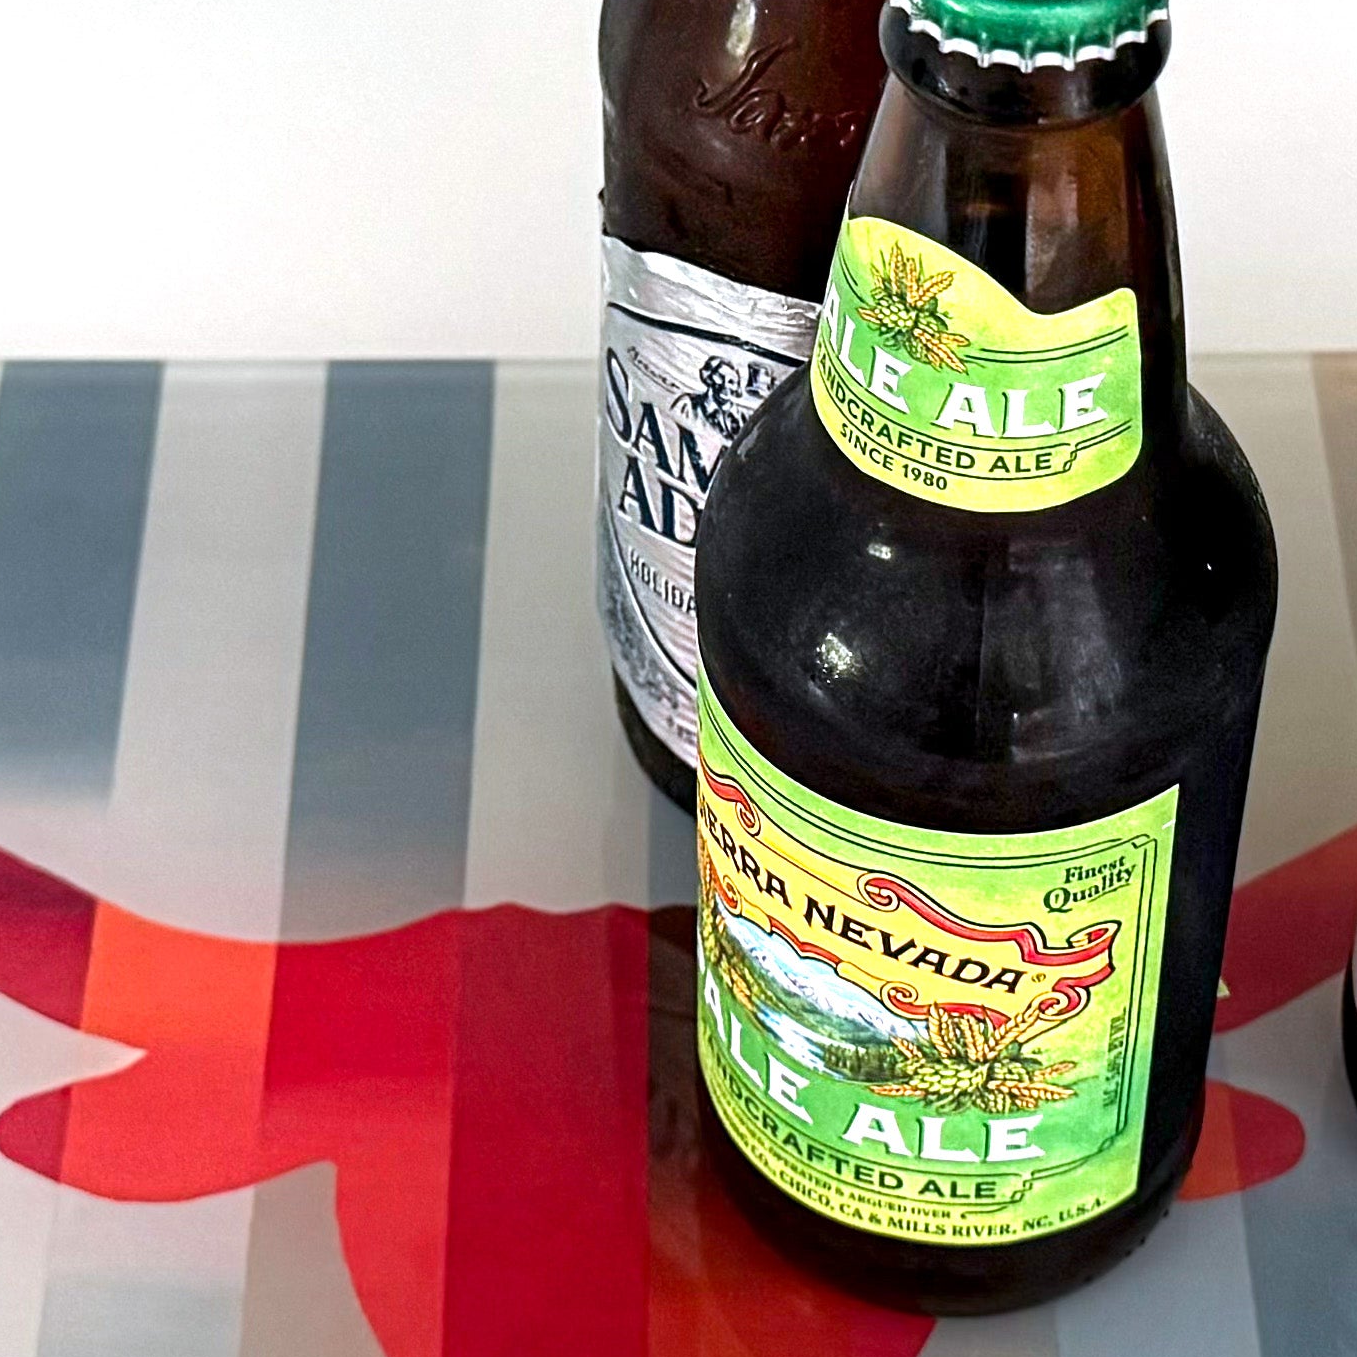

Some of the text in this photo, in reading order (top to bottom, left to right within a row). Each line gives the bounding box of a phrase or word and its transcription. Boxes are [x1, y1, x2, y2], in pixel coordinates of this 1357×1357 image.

[823, 283, 1109, 438] ALE ALE
[606, 346, 729, 494] SAM
[840, 422, 948, 491] SINCE 1980
[988, 452, 1053, 473] ALE
[1044, 864, 1136, 913] Quality
[1064, 855, 1127, 885] Finest
[803, 893, 1029, 994] NEVADA
[697, 933, 813, 1125] ALE
[840, 1101, 1045, 1164] ALE
[848, 1192, 907, 1214] ARGUED
[911, 1207, 951, 1220] OVER
[918, 1179, 997, 1200] ALE
[840, 1203, 863, 1220] CA
[869, 1213, 882, 1225] &
[887, 1216, 946, 1236] MILLS
